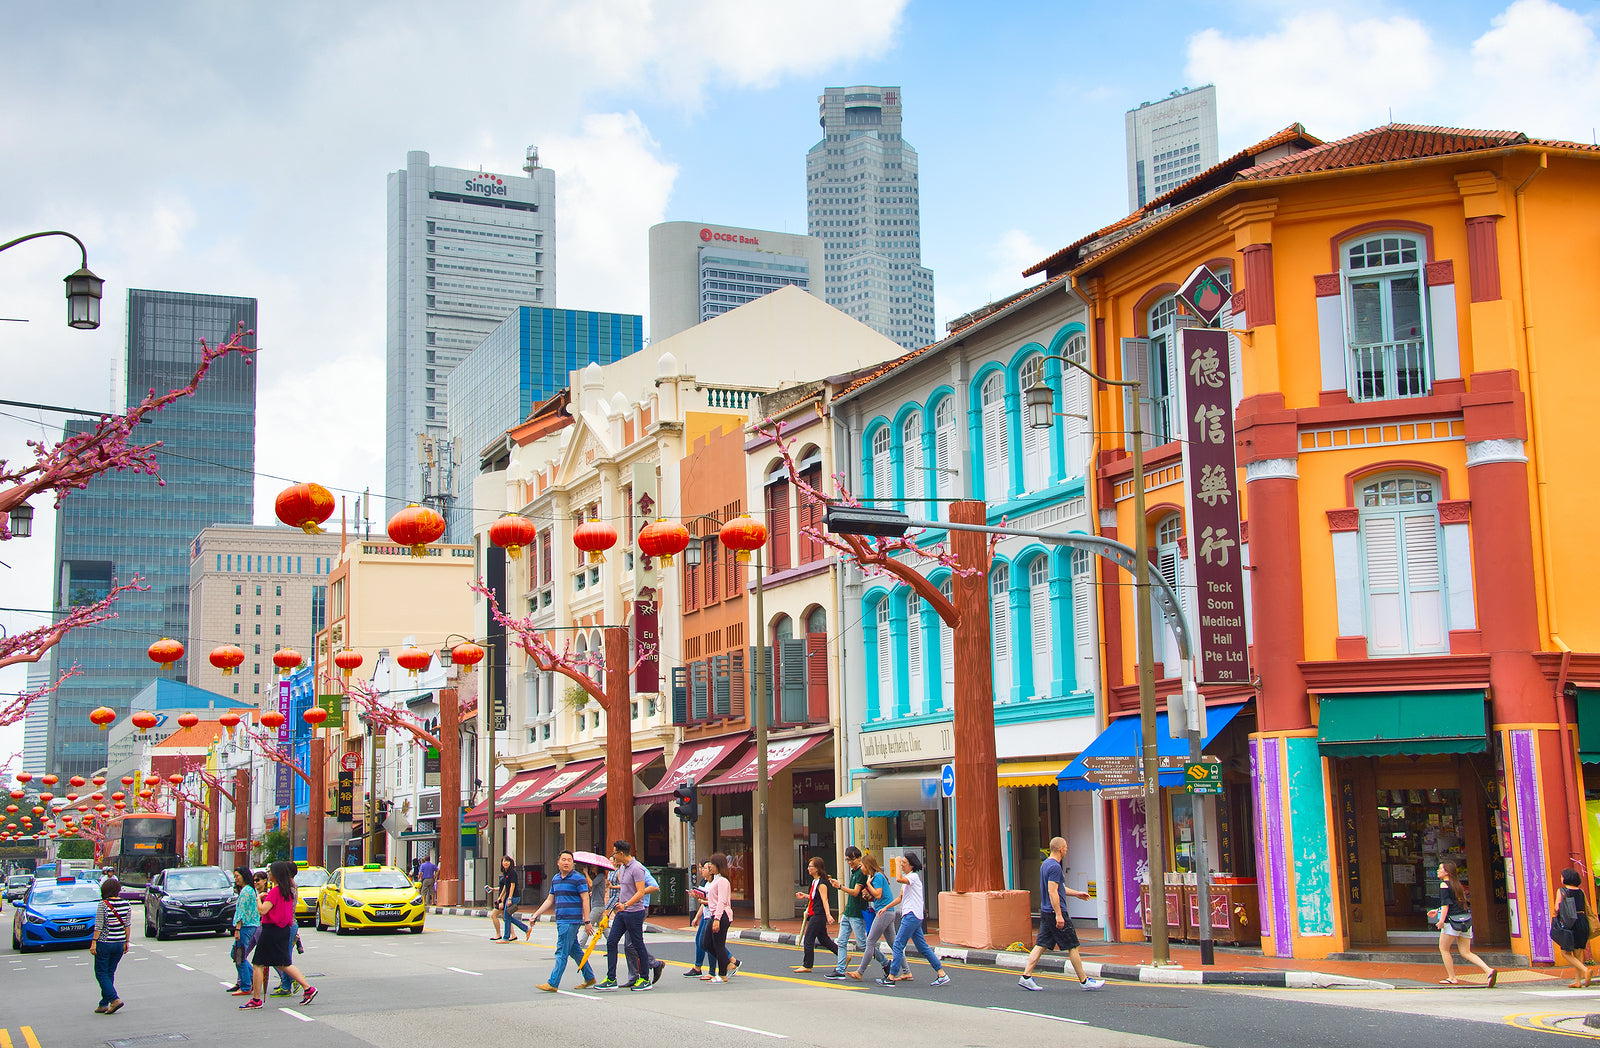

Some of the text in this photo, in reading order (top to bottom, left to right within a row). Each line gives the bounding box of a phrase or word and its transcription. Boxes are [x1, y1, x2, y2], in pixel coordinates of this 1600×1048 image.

[465, 179, 507, 197] Singtel
[704, 232, 759, 246] OCBC Bank
[1190, 347, 1236, 568] 德信藥行
[1207, 581, 1232, 593] Teck
[1207, 598, 1234, 610] Soon
[1202, 615, 1241, 627] Medical
[643, 631, 654, 639] Eu
[1213, 633, 1232, 645] Hall
[1205, 651, 1243, 662] Pte Ltd
[1218, 670, 1233, 679] 281
[863, 736, 875, 757] South
[874, 734, 888, 759] Bridge
[887, 732, 910, 755] Aesthetics
[908, 731, 922, 752] Clinic
[344, 754, 358, 770] 當
[340, 778, 353, 815] 金裕源
